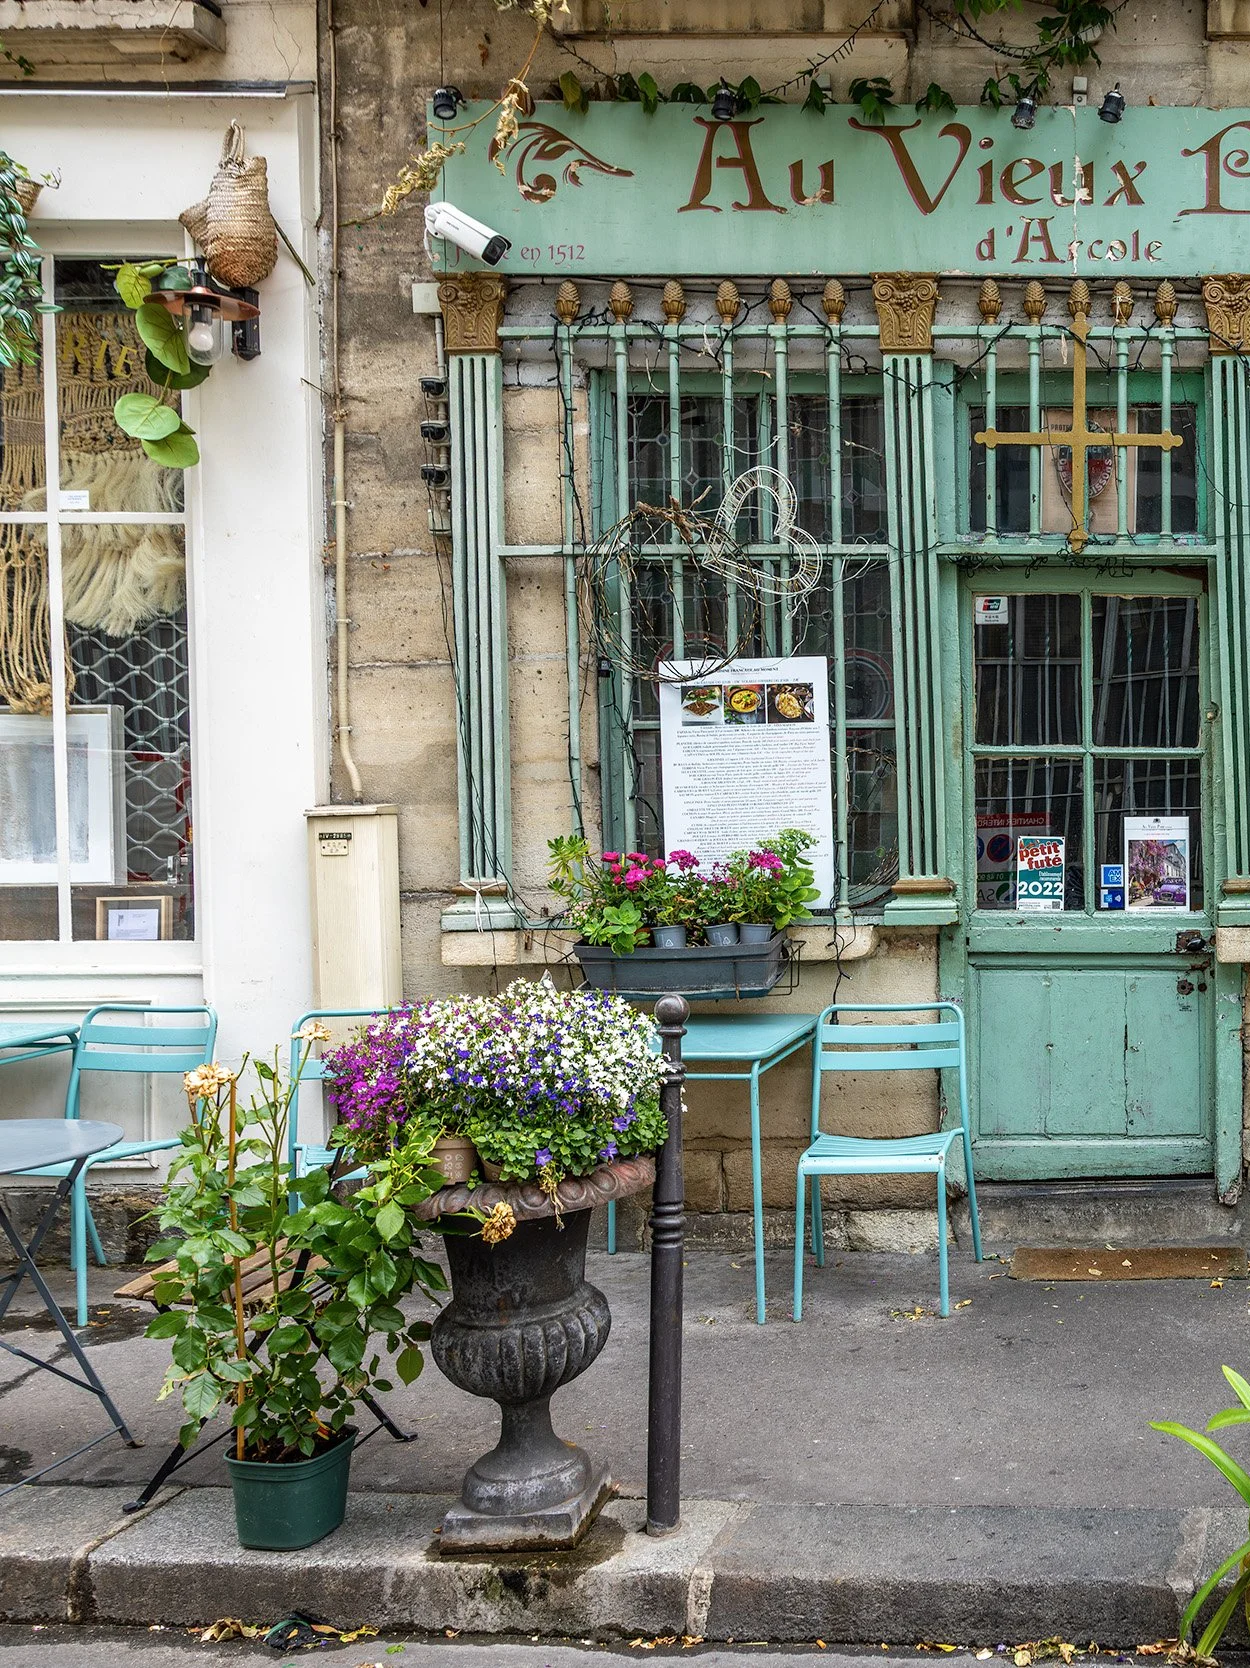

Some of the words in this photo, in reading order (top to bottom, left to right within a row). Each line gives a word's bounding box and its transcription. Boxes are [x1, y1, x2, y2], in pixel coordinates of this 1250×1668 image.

[677, 116, 836, 214] Au
[848, 116, 1147, 216] Vieux
[975, 215, 1164, 263] d'Arcole
[520, 246, 541, 268] en
[548, 244, 585, 265] 1512
[1019, 841, 1060, 862] petit
[1027, 854, 1062, 870] futé
[1018, 881, 1063, 896] 2022
